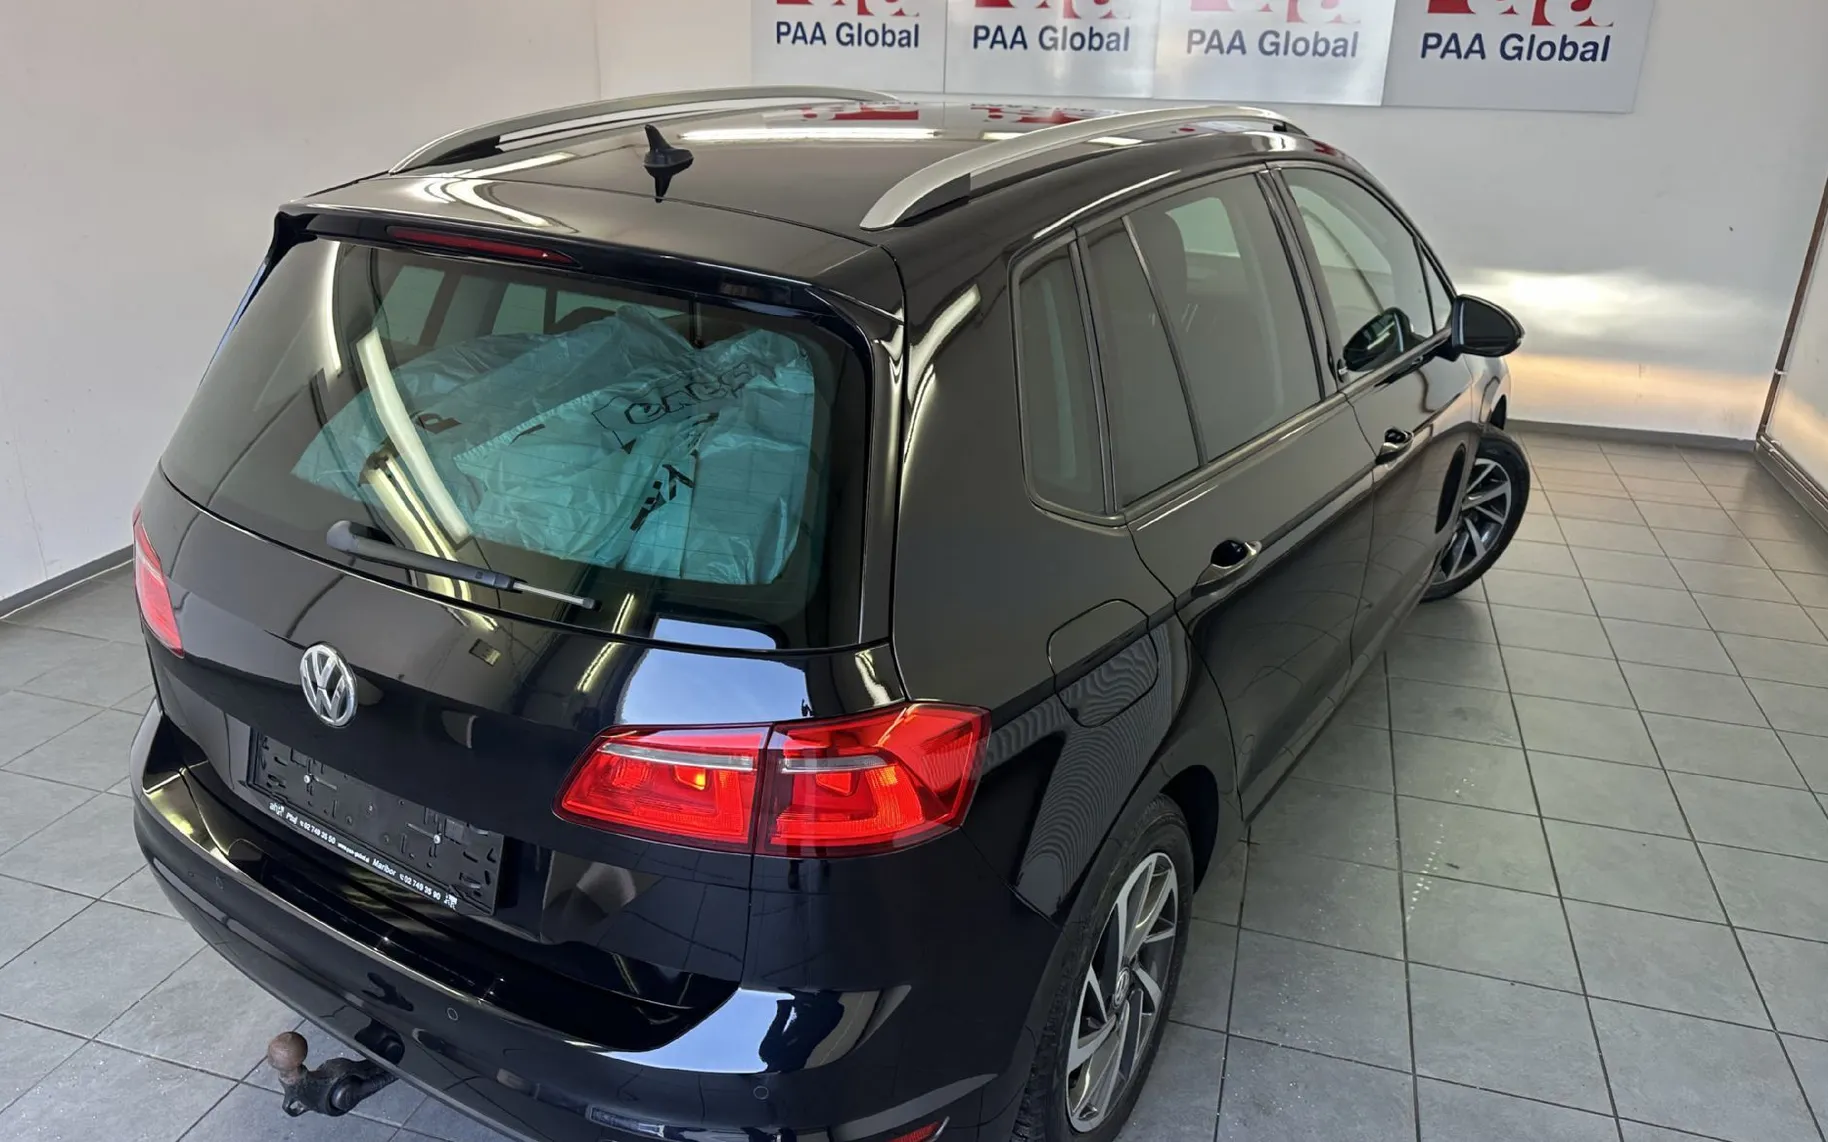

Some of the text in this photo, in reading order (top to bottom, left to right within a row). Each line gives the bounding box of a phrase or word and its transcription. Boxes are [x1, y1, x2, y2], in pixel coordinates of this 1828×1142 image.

[776, 21, 919, 48] PAA Global
[973, 25, 1130, 52] PAA Global
[1187, 29, 1359, 57] PAA Global
[1420, 32, 1611, 62] PAA Global
[372, 859, 396, 876] Maribor
